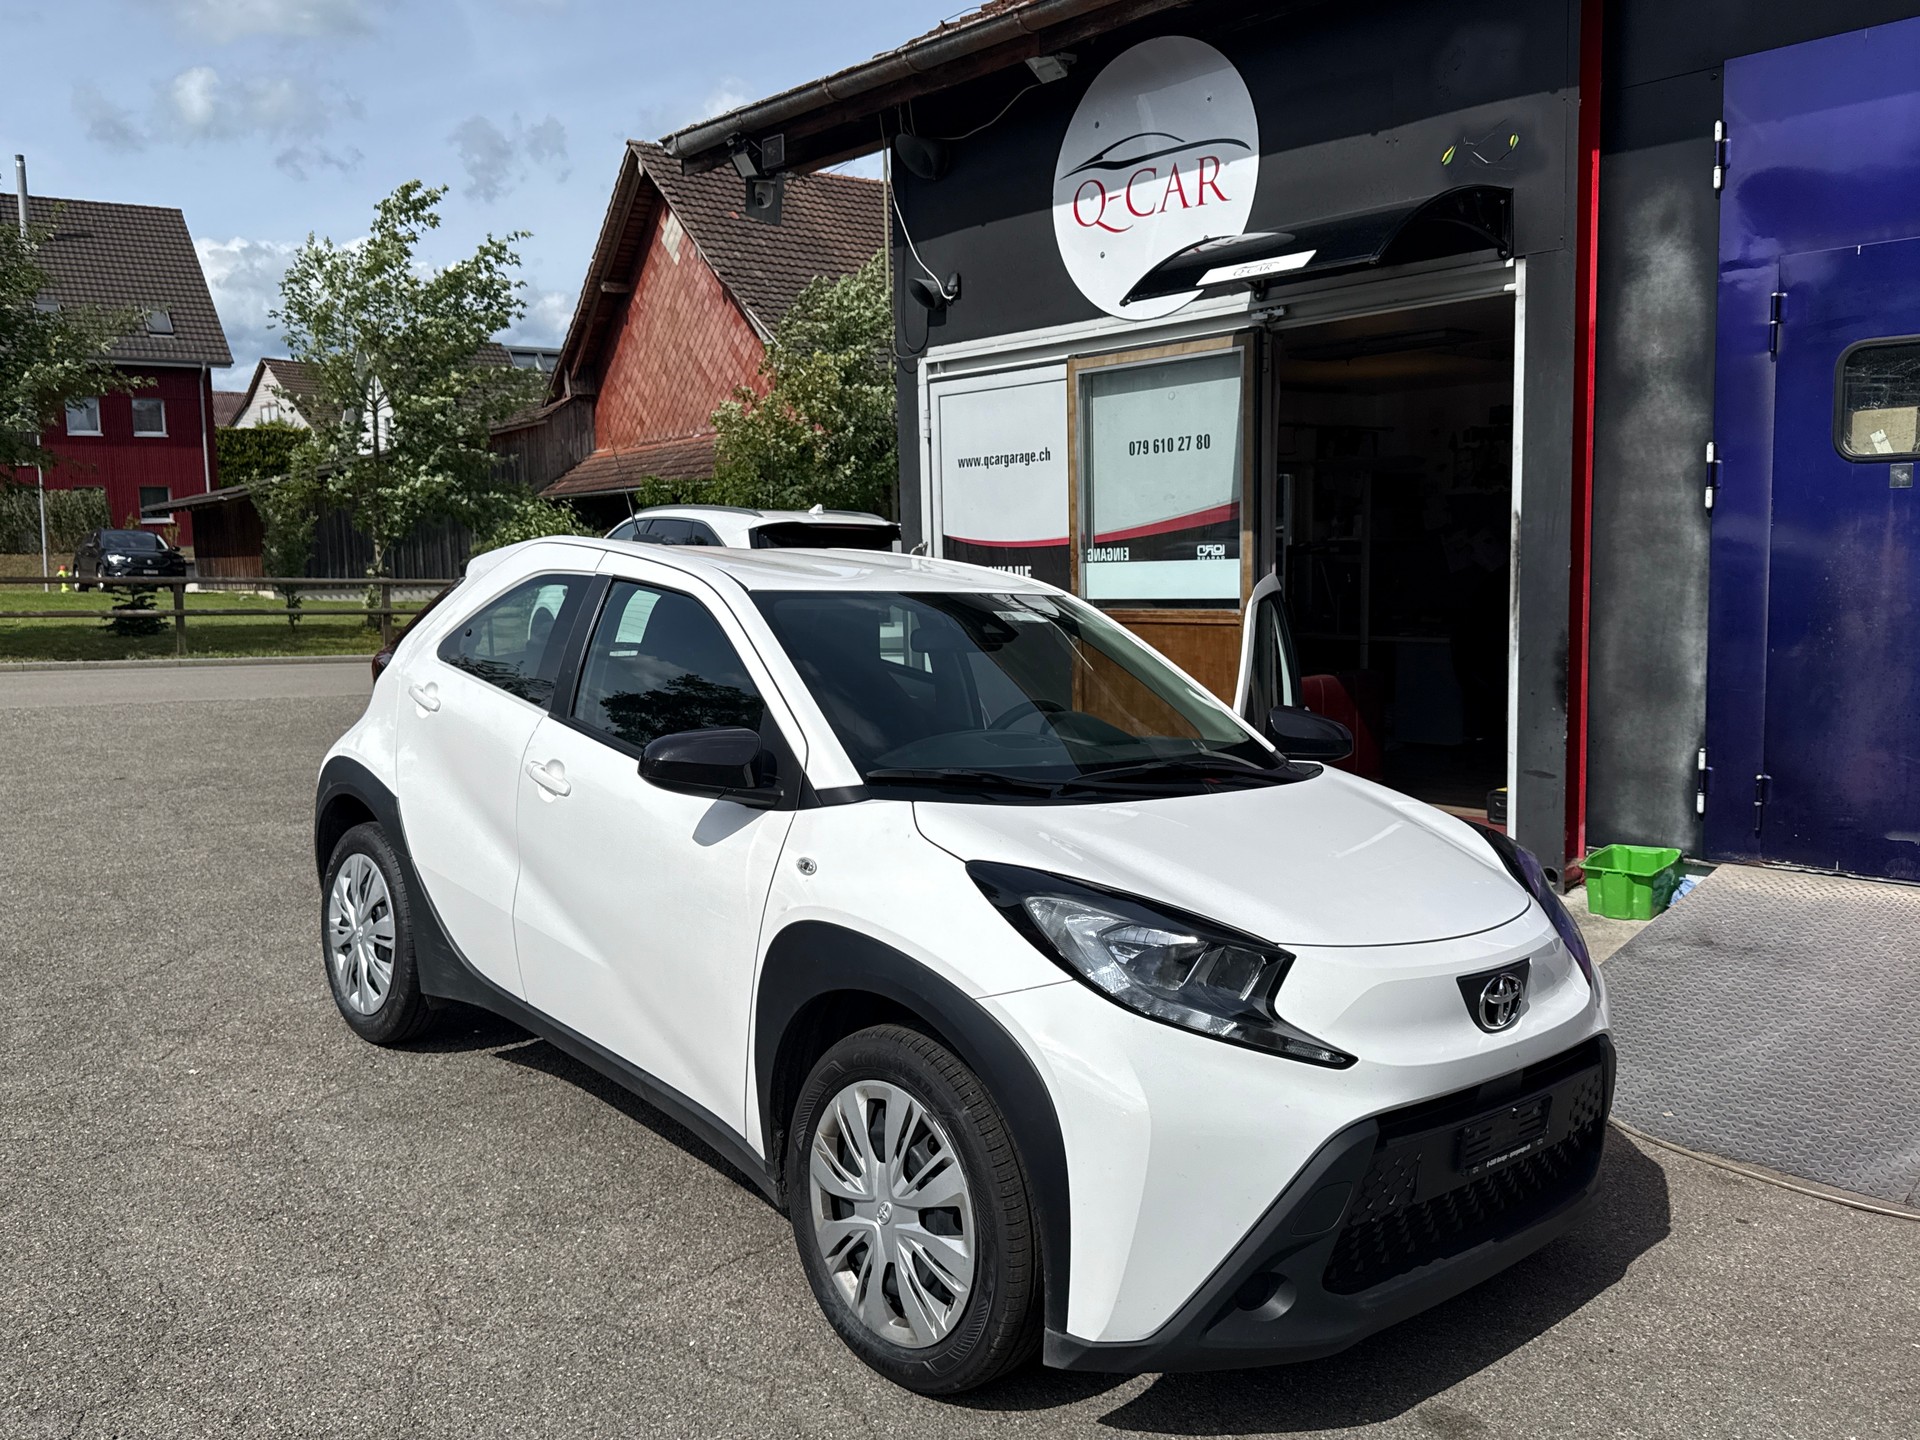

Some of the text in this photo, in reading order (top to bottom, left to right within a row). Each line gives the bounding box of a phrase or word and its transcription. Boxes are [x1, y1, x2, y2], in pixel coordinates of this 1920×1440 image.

[1073, 155, 1232, 233] Q-CAR
[1129, 433, 1211, 456] 079 610 27 80
[957, 446, 1051, 469] www.qcargarage.ch
